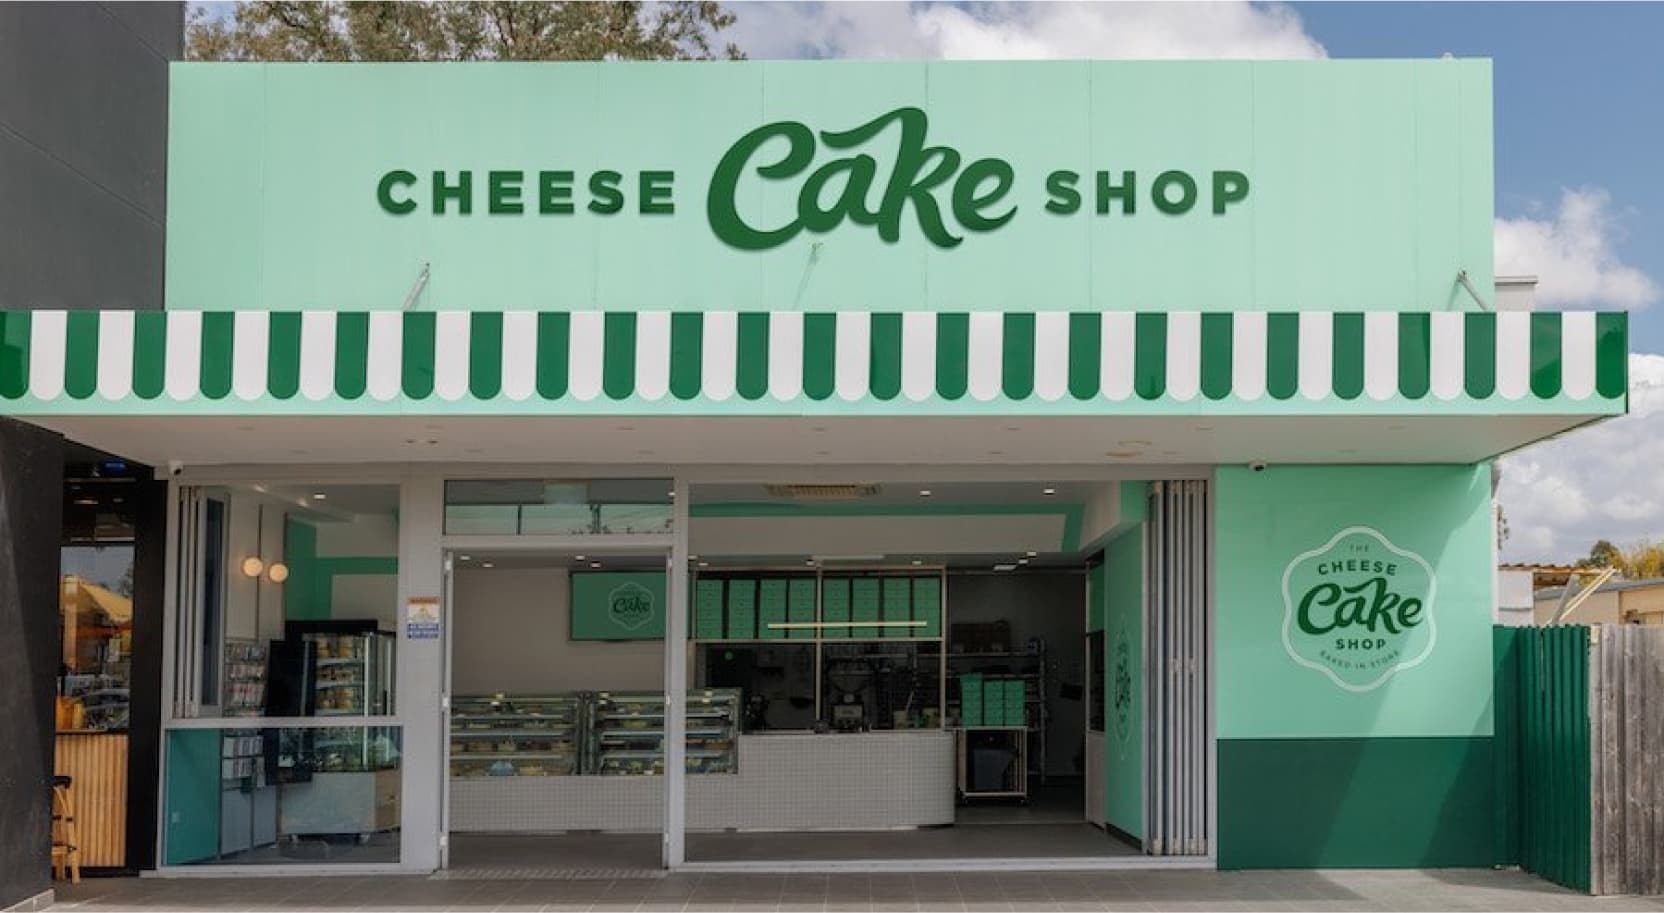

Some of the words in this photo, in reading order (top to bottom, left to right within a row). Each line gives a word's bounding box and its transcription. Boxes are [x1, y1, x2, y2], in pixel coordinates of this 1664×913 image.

[377, 170, 675, 215] CHEESE
[707, 107, 1018, 251] Cake
[1045, 170, 1250, 215] SHOP
[1318, 560, 1398, 576] CHEESE
[1297, 577, 1423, 635] Cake
[1336, 638, 1386, 650] SHOP
